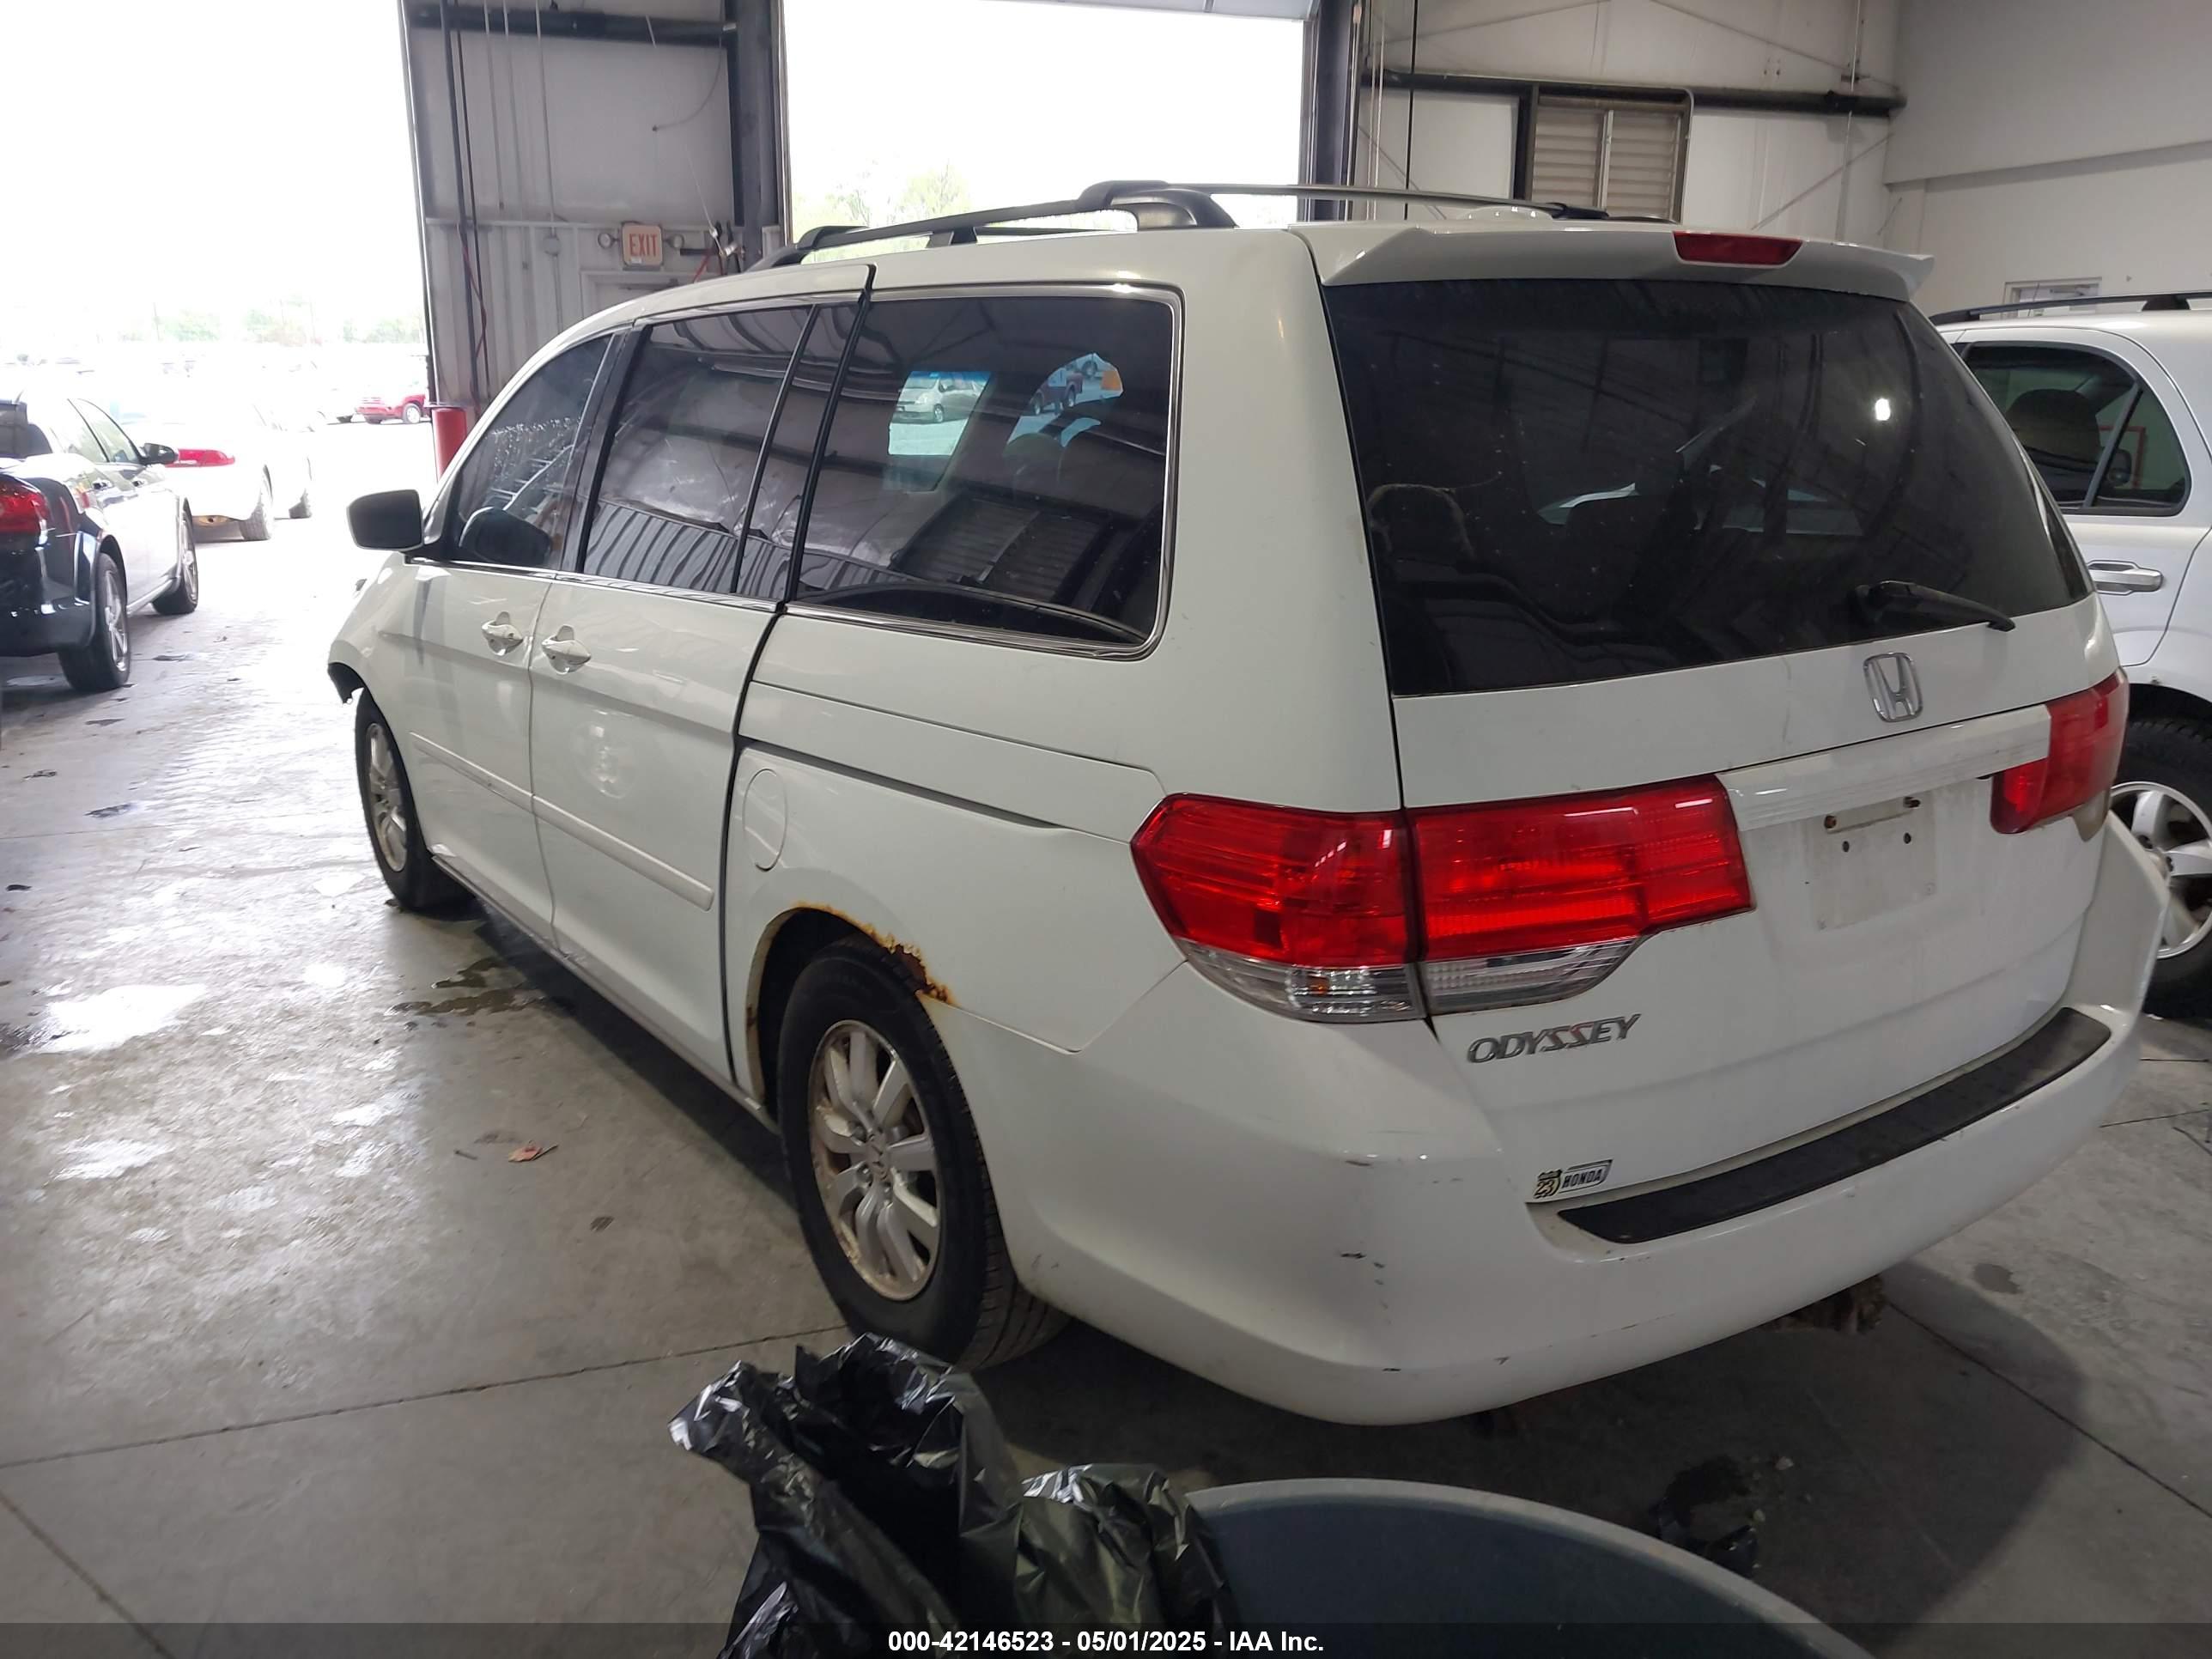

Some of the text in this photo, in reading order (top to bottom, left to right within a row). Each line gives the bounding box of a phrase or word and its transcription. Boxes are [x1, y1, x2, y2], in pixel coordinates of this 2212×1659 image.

[629, 233, 658, 257] EXIT
[1468, 1013, 1642, 1063] ODYSSEY
[1561, 1169, 1603, 1189] HONDA
